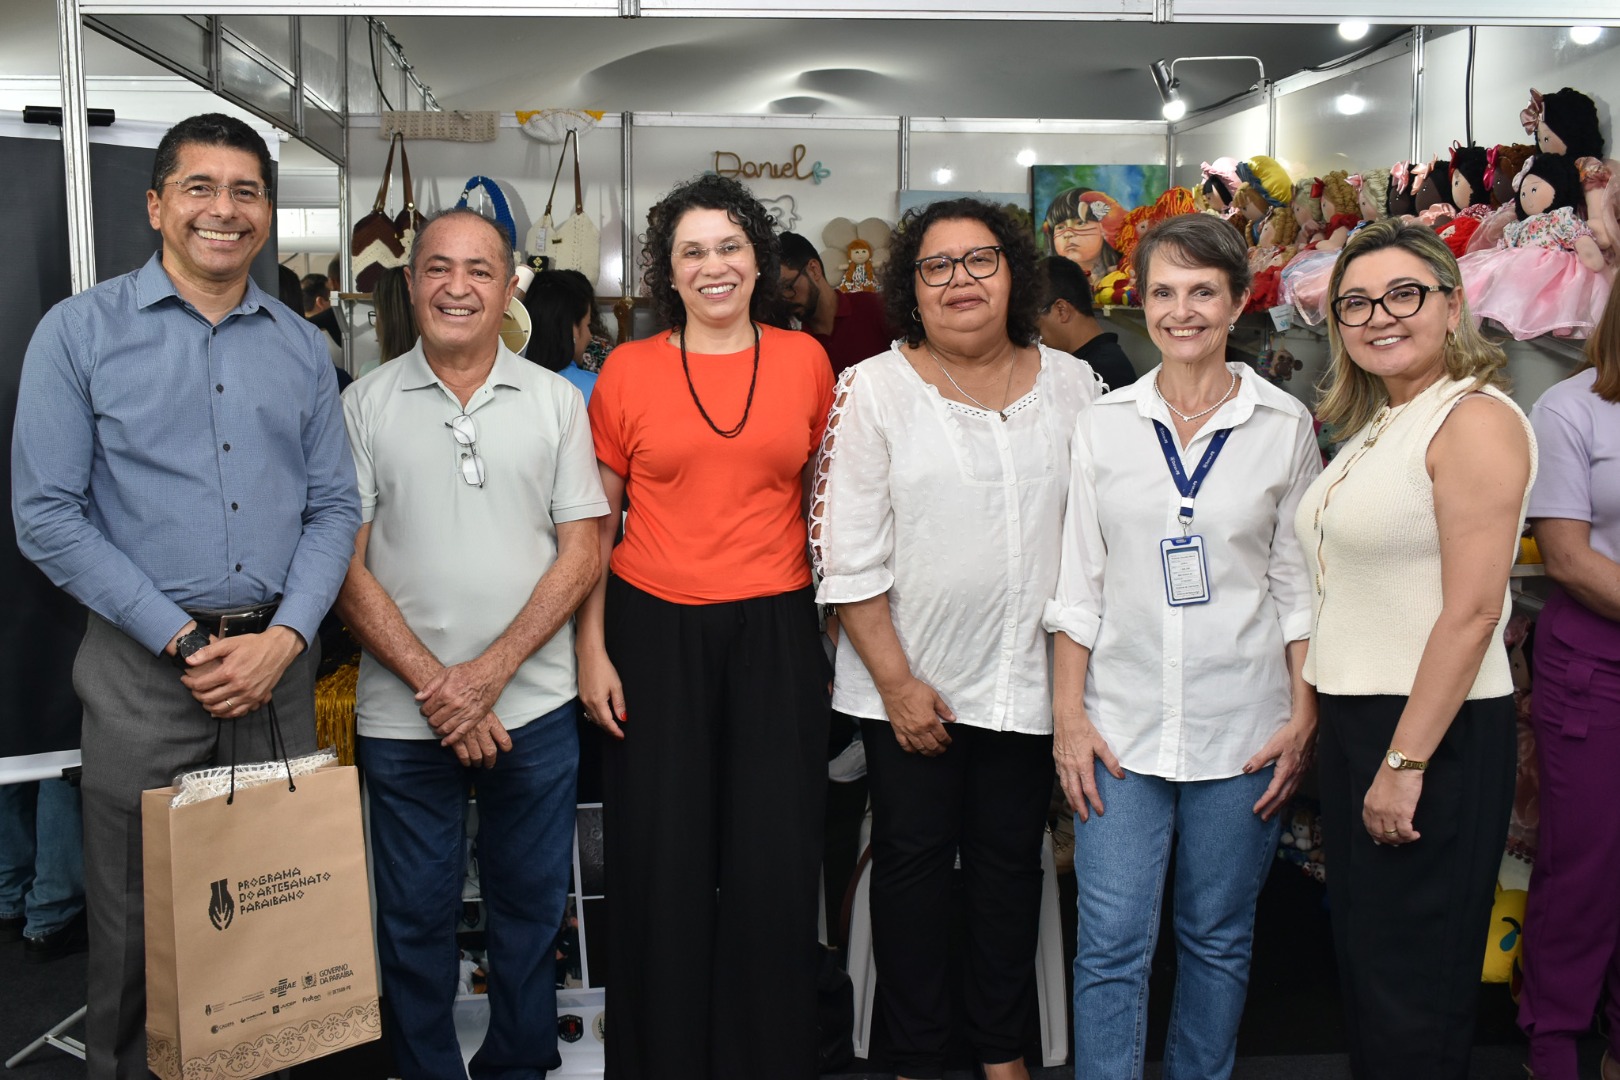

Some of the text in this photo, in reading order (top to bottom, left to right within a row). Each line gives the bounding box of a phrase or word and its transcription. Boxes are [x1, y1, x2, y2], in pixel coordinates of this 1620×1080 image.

[716, 144, 814, 180] Daniel
[238, 867, 301, 891] PROGRAMA
[239, 872, 331, 903] DO ARTESANATO
[240, 890, 304, 915] PARAIBANO
[319, 963, 348, 977] GOVERNO
[319, 976, 329, 985] DA
[270, 981, 297, 994] SEBRAE
